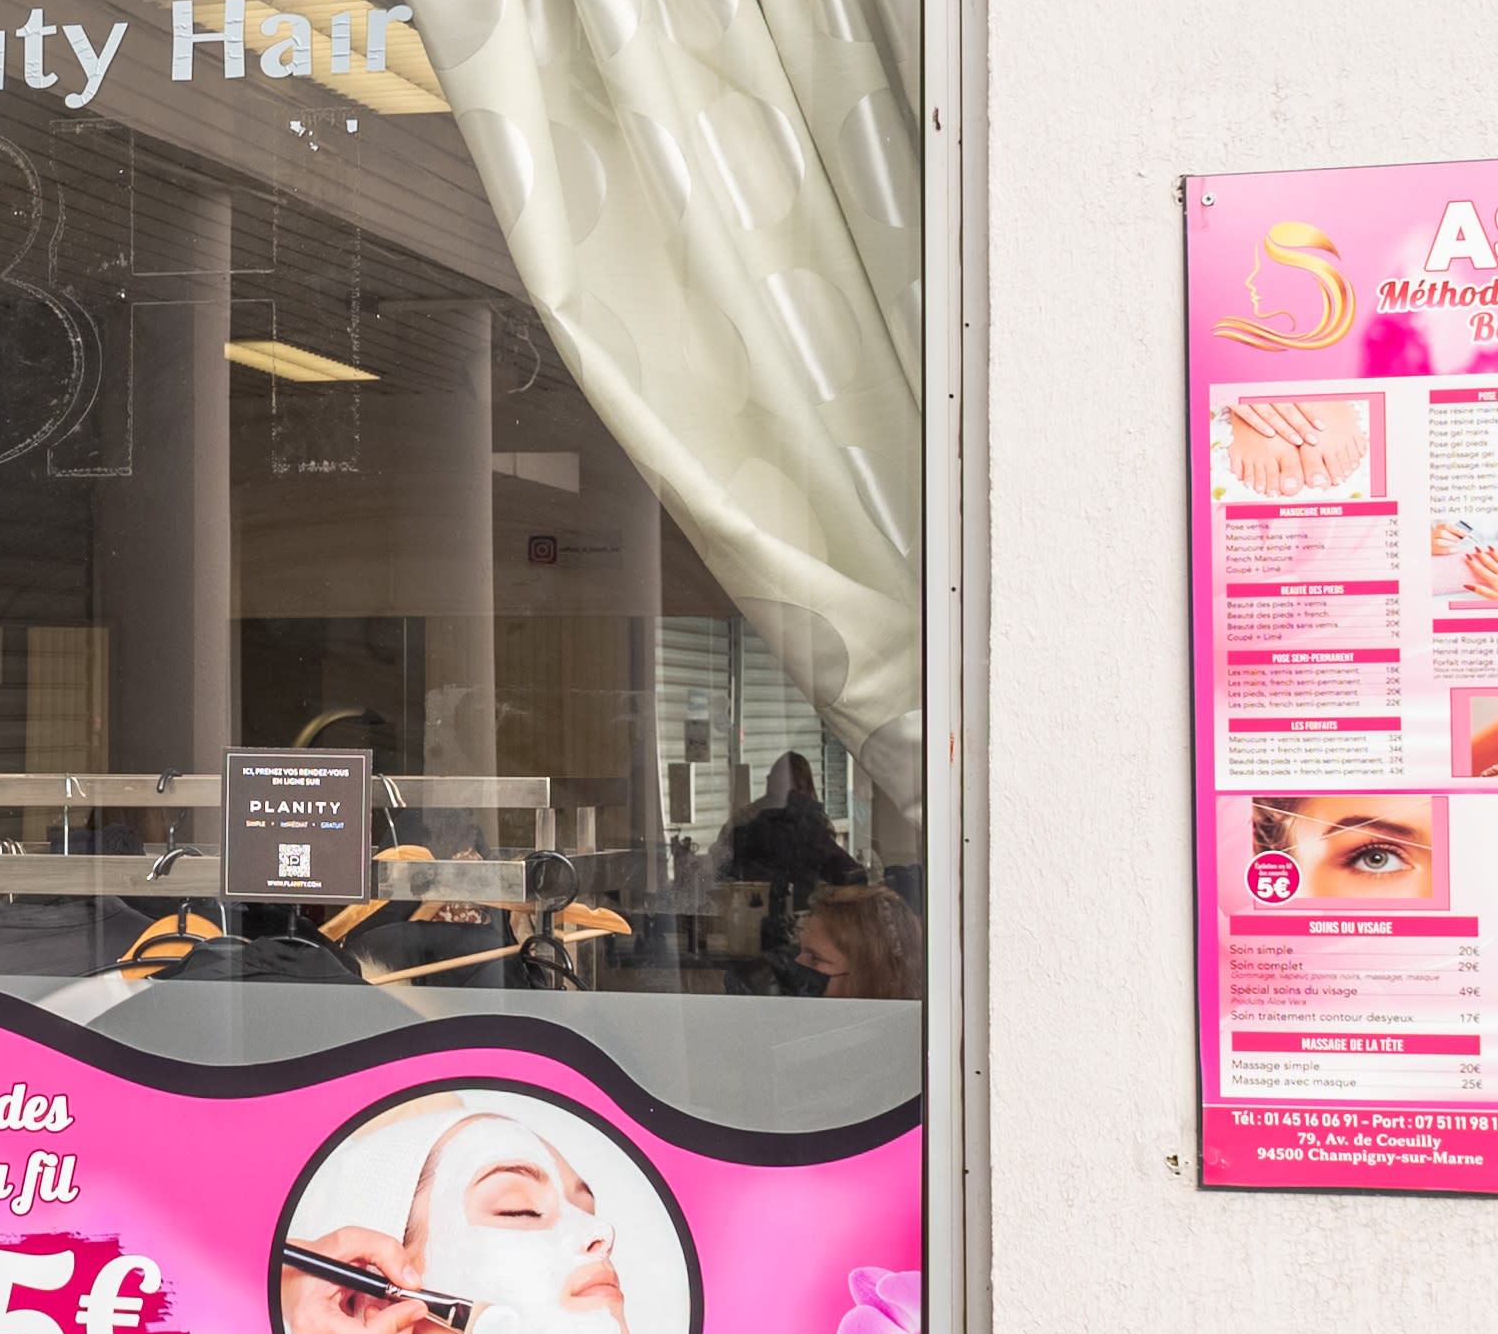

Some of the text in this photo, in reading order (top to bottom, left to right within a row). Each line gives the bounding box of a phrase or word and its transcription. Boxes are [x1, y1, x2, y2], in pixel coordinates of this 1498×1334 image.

[250, 800, 341, 814] PLANITY
[1256, 877, 1290, 898] 5€
[1309, 921, 1393, 934] SOINS DU VISAGE
[1232, 1111, 1254, 1124] Tél
[1265, 1112, 1279, 1125] 01
[1282, 1113, 1300, 1125] 45
[1305, 1113, 1318, 1126] 16
[1322, 1113, 1340, 1127] 06
[1345, 1114, 1358, 1127] 91
[1373, 1115, 1405, 1129] Port
[1416, 1116, 1432, 1129] 07
[1437, 1116, 1451, 1129] 51
[1455, 1116, 1467, 1130] 11
[1471, 1117, 1489, 1130] 98
[1298, 1133, 1321, 1147] 79,
[1326, 1133, 1349, 1145] Av.
[1354, 1133, 1372, 1146] de
[1257, 1147, 1484, 1165] 94500 Champigny-sur-Marne
[11, 1151, 79, 1216] fil
